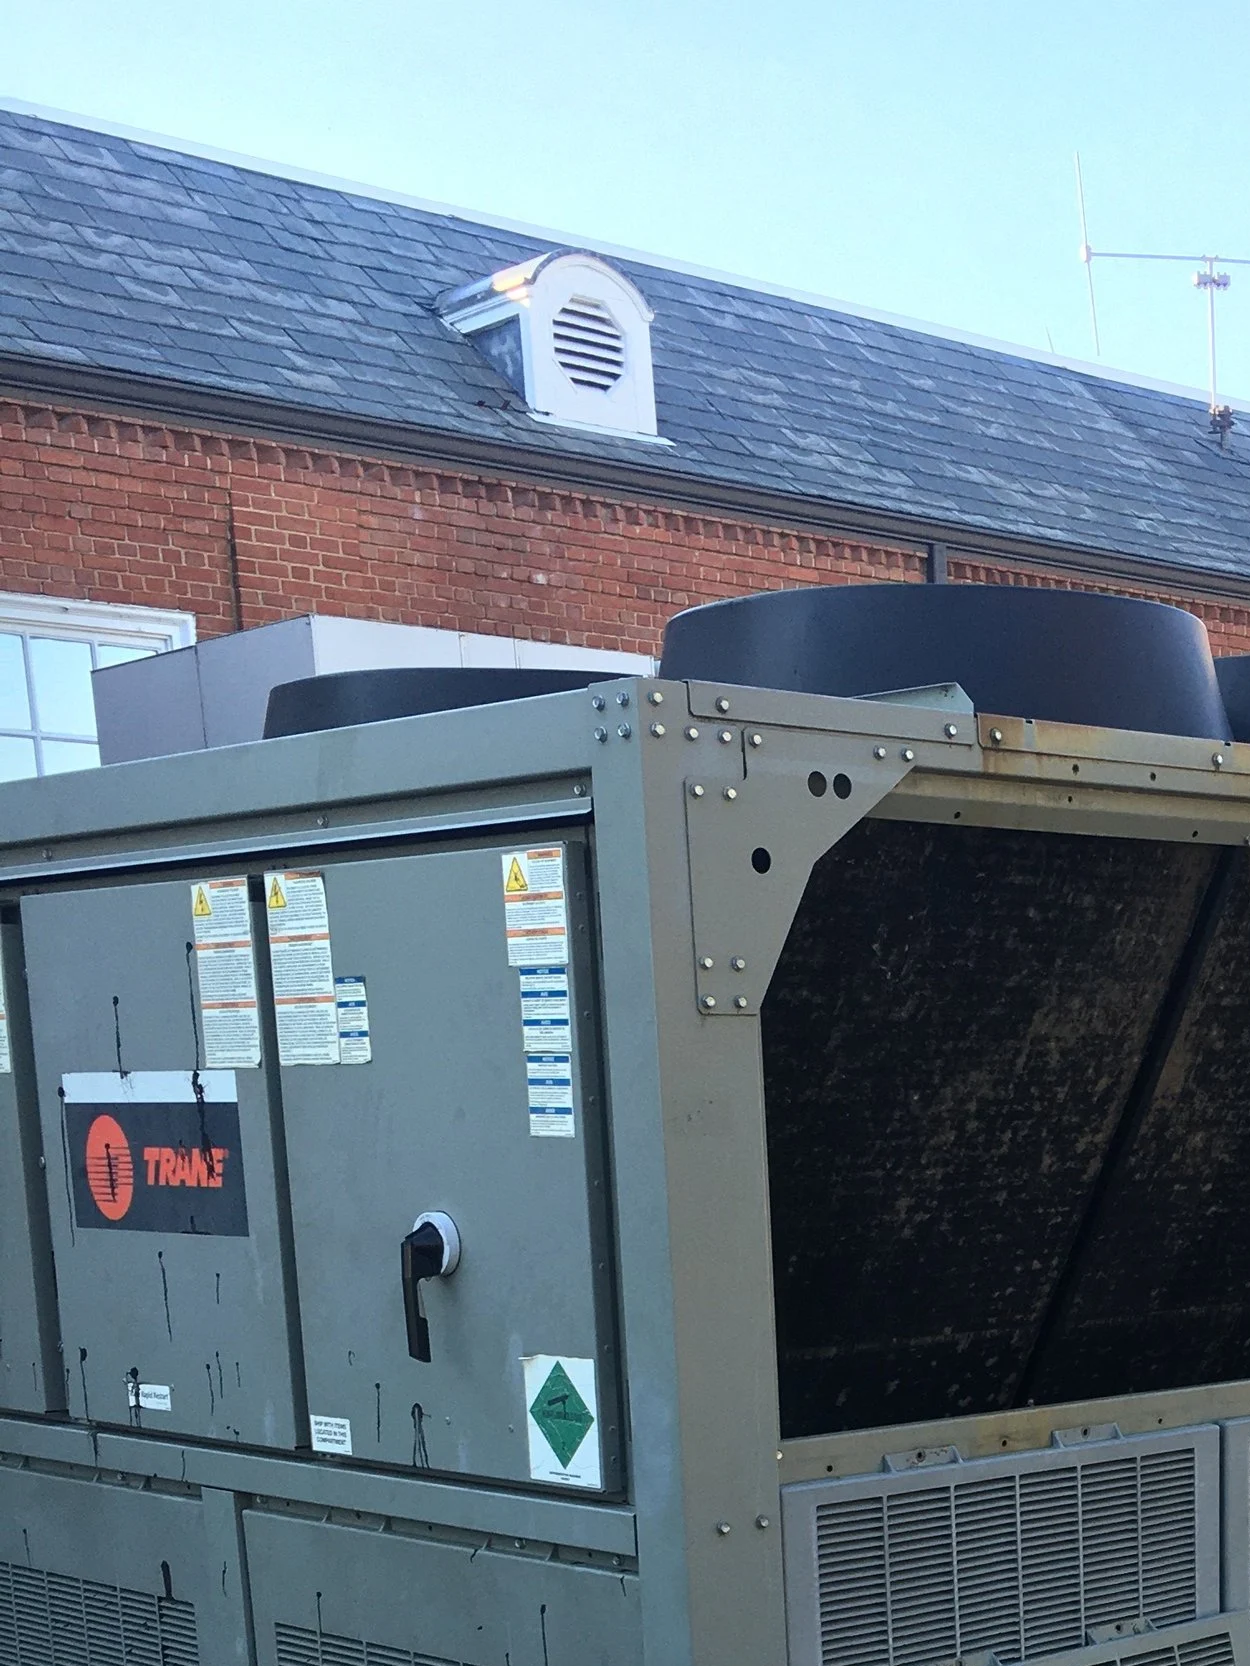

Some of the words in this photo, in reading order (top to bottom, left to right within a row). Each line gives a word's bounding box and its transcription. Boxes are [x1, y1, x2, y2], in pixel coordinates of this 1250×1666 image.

[143, 1146, 224, 1188] TRANE
[153, 1392, 169, 1400] Restart
[334, 1422, 347, 1430] ITEMS
[314, 1428, 332, 1436] LOCATED
[338, 1430, 347, 1438] THIS
[316, 1436, 347, 1445] COMPARTMENT
